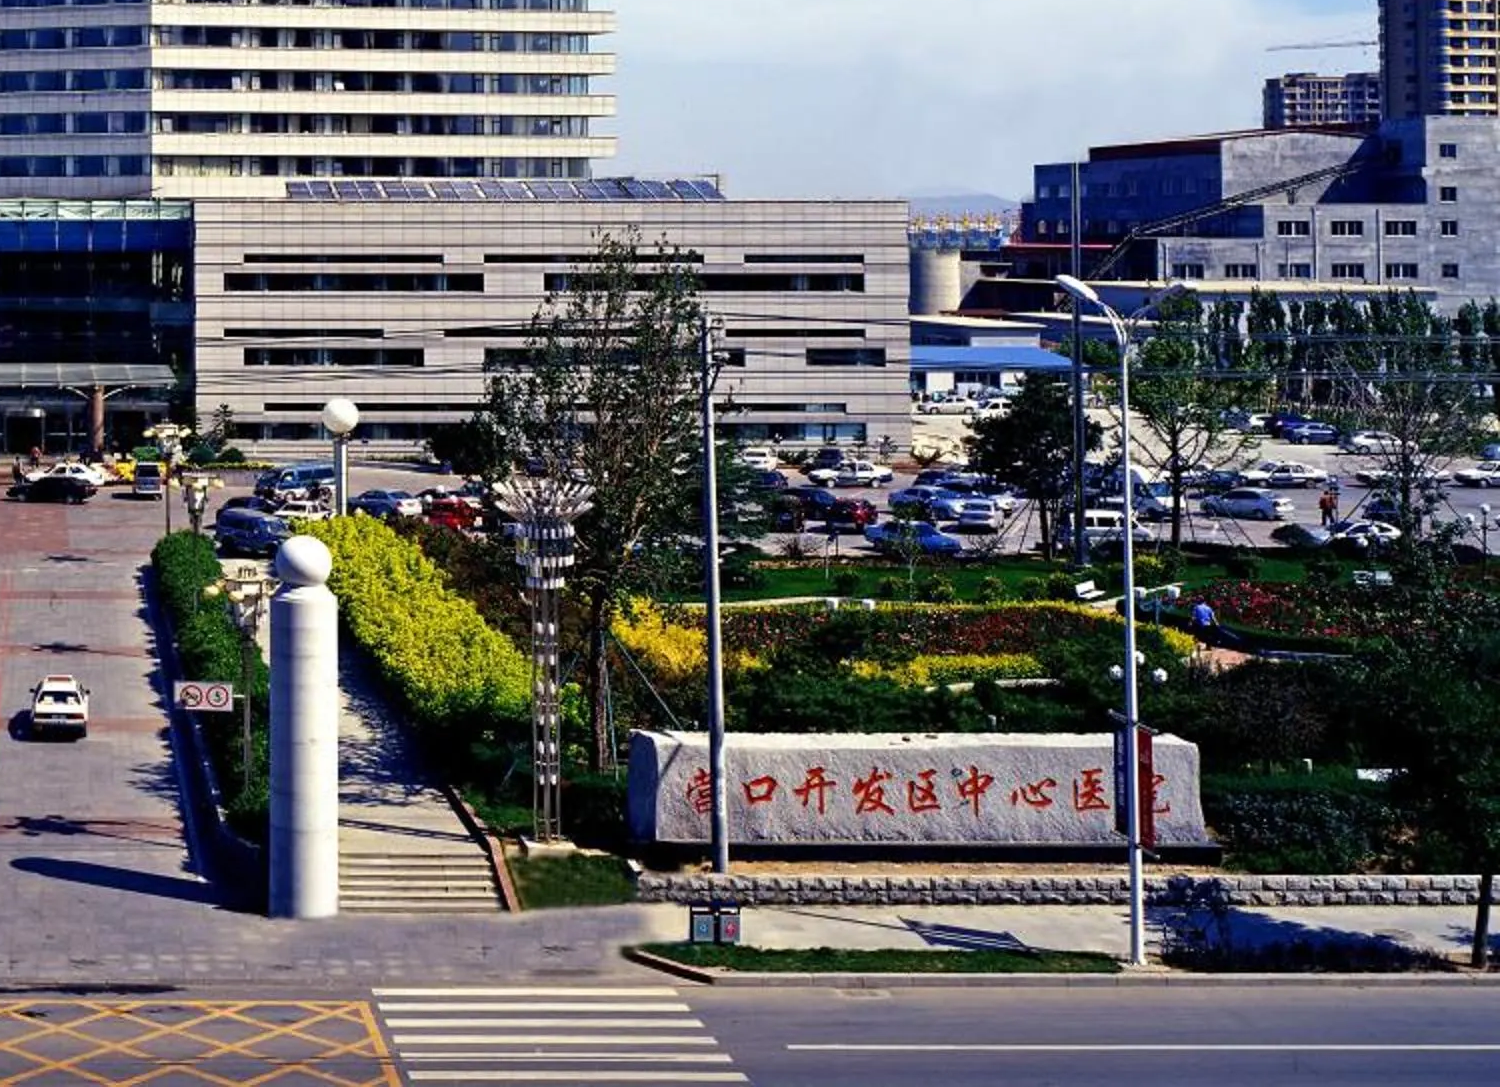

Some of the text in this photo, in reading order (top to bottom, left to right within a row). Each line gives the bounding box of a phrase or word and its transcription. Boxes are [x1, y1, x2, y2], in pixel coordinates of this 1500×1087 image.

[685, 765, 1170, 817] 营口开发区中心医
